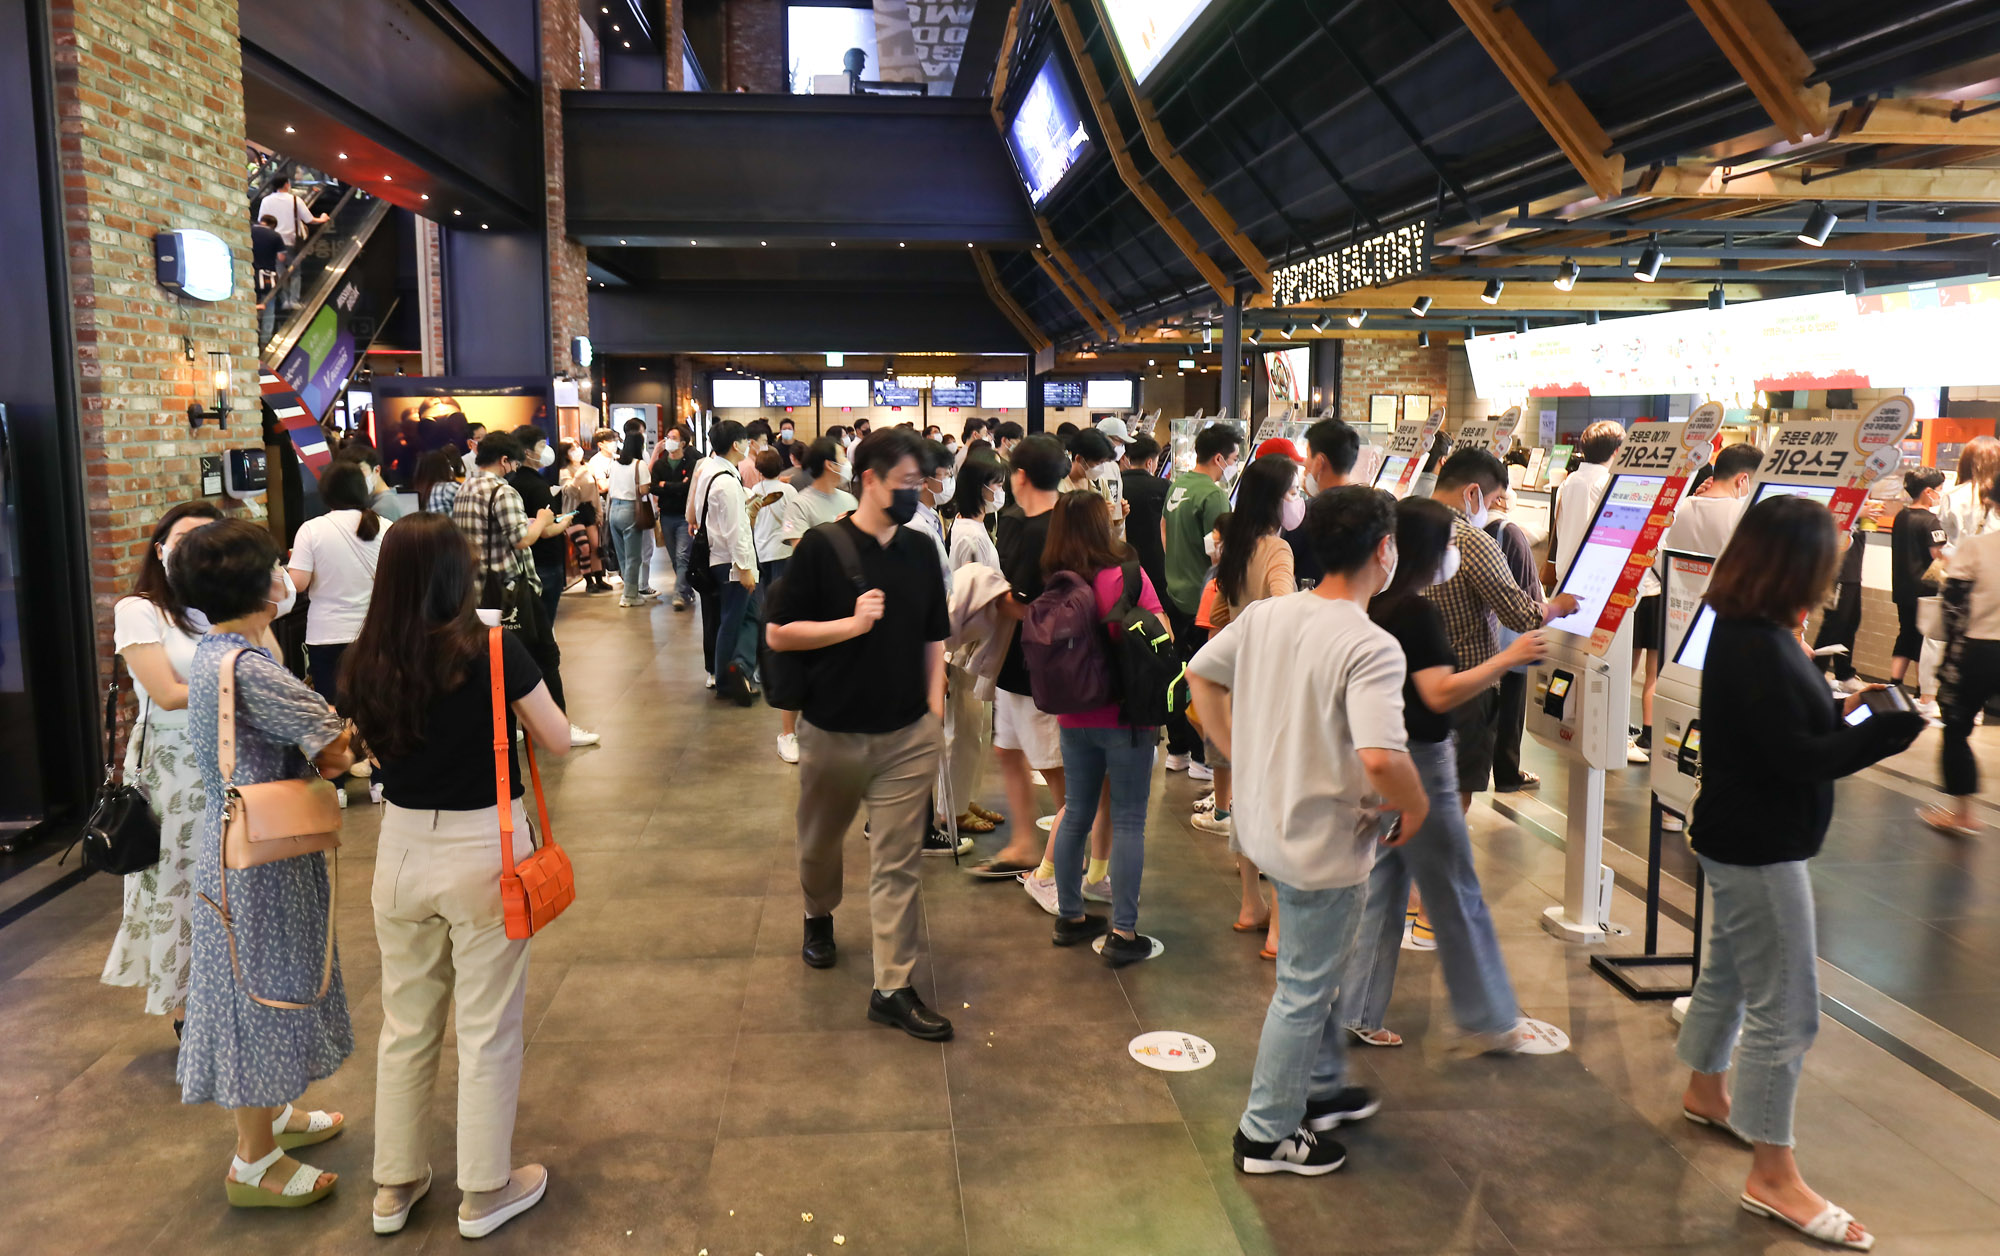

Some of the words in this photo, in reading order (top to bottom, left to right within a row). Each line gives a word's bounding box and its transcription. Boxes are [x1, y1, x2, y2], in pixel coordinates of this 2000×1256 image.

[1272, 251, 1339, 308] POPCORN
[1342, 220, 1426, 292] FACTORY
[1389, 436, 1418, 452] 키오스크
[1628, 430, 1652, 444] 주문은
[1651, 431, 1671, 443] 여기!
[1779, 431, 1811, 446] 주문은
[1811, 431, 1838, 446] 여기!
[1616, 446, 1677, 468] 키오스크
[1764, 449, 1849, 477] 키오스크
[1659, 496, 1675, 507] TIP!
